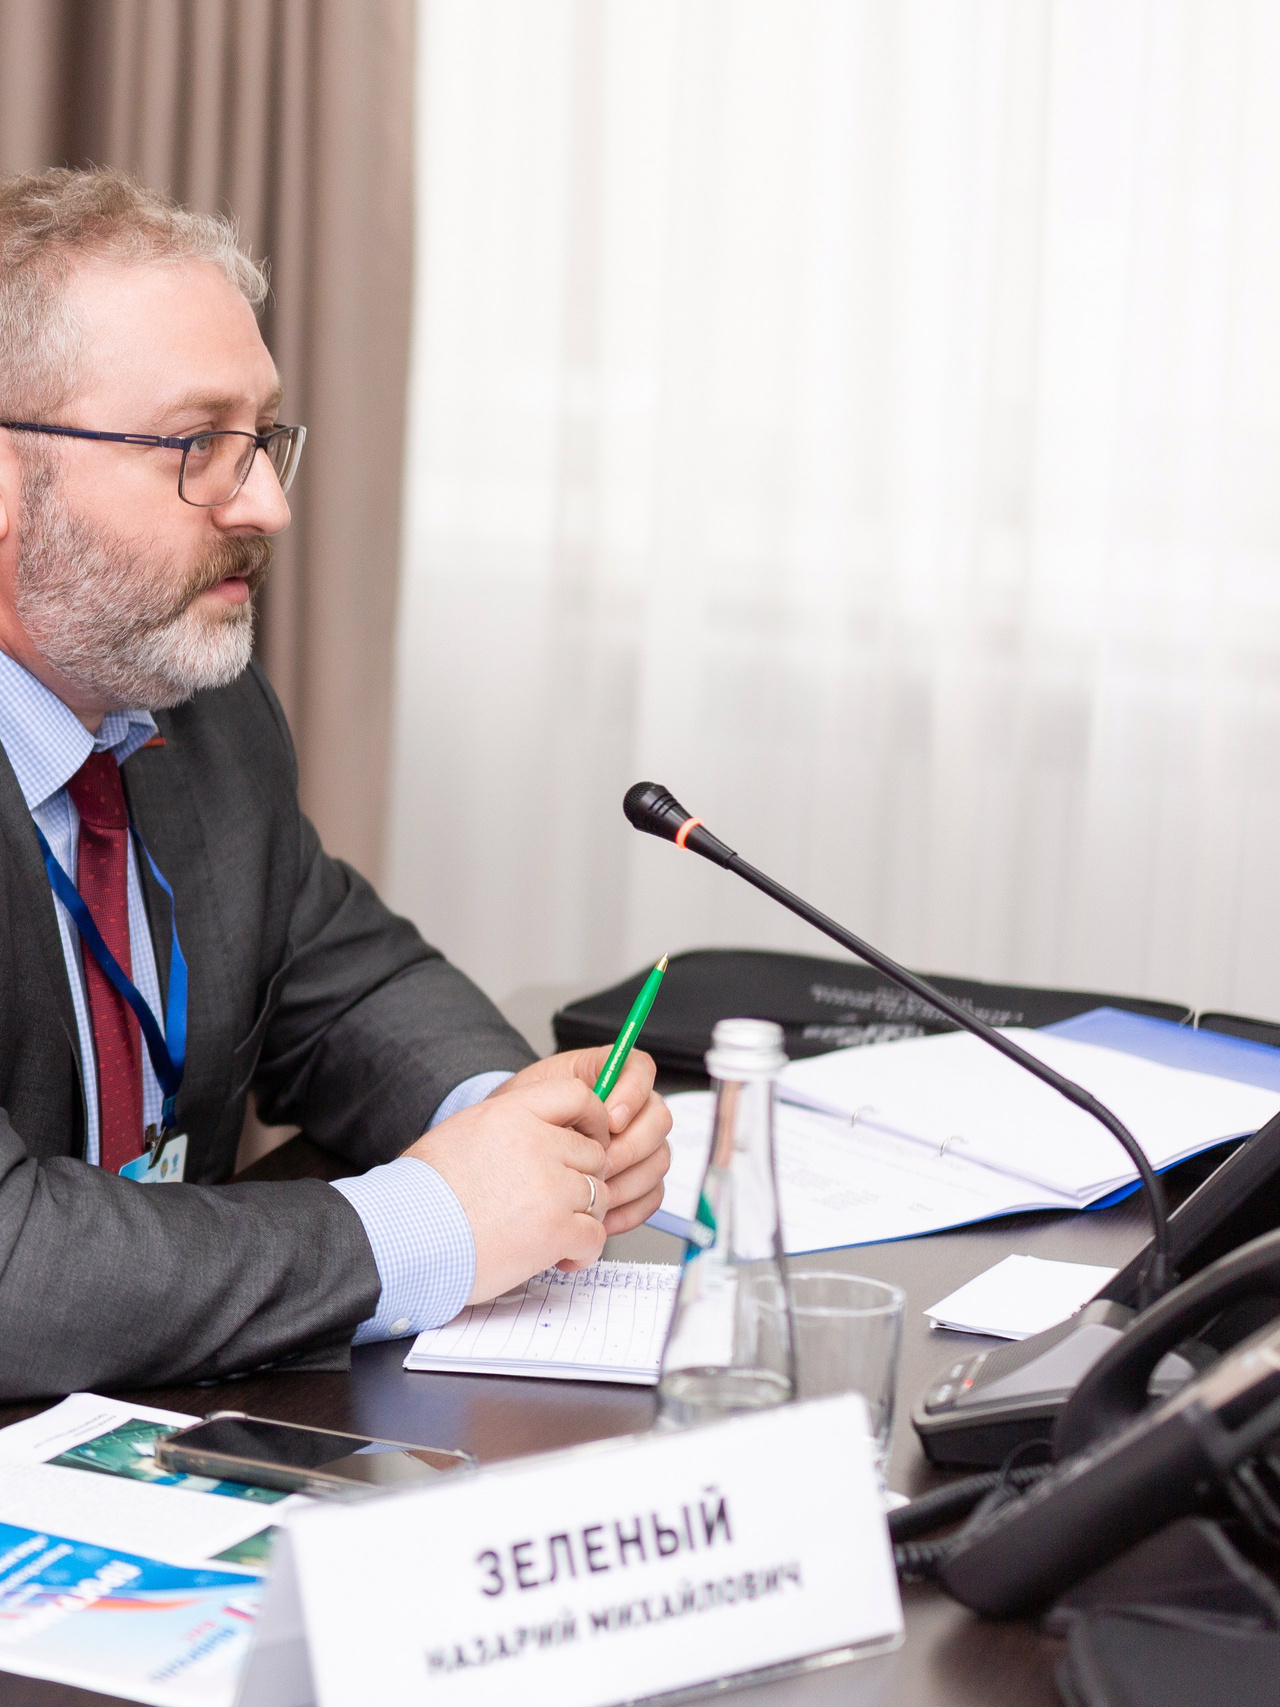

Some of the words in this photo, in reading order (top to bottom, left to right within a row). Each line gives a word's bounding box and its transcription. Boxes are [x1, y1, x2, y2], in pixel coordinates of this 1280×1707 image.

[476, 1484, 733, 1597] ЗЕЛЕНЫЙ
[426, 1608, 577, 1677] НАЗАРИЙ
[589, 1561, 803, 1634] МИХАЙЛОВИЧ
